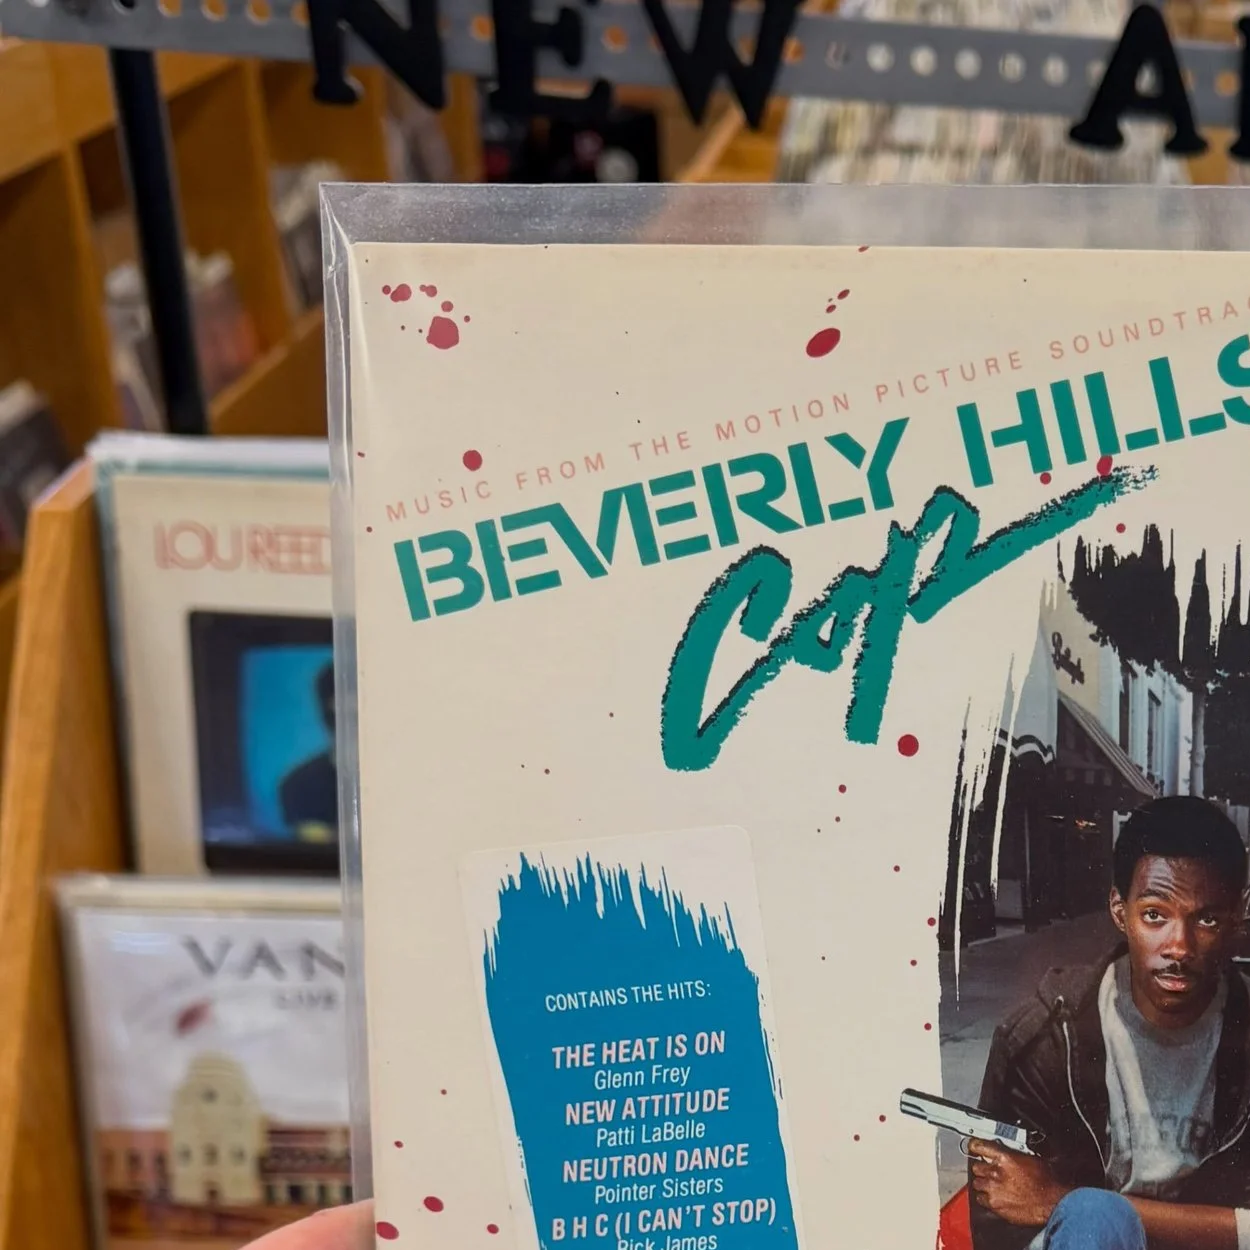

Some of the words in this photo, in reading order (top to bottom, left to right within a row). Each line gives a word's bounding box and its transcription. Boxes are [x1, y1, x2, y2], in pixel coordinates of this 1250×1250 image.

[308, 0, 802, 130] NEW
[386, 479, 493, 522] MUSIC
[514, 451, 606, 490] FROM
[629, 430, 692, 462] THE
[714, 392, 851, 441] MOTION
[875, 350, 1024, 403] PICTURE
[394, 416, 911, 622] BEVERLY
[153, 519, 244, 572] LOU
[661, 464, 1161, 773] Cop
[544, 988, 629, 1013] CONTAINS
[630, 984, 665, 1004] THE
[667, 979, 713, 1001] HITS:
[551, 1042, 596, 1070] THE
[601, 1036, 660, 1066] HEAT
[665, 1033, 688, 1059] IS
[694, 1029, 726, 1056] ON
[593, 1069, 645, 1091] Glenn
[651, 1063, 692, 1087] Frey
[564, 1098, 617, 1126] NEW
[621, 1087, 731, 1121] ATTITUDE
[596, 1125, 635, 1148] Patti
[641, 1119, 706, 1144] LaBelle
[562, 1150, 668, 1183] NEUTRON
[675, 1142, 750, 1173] DANCE
[594, 1182, 657, 1205] Pointer
[661, 1176, 724, 1199] Sisters
[551, 1217, 566, 1241] B
[572, 1215, 588, 1239] H
[594, 1213, 609, 1238] C
[614, 1211, 632, 1241] (I
[637, 1204, 706, 1234] CAN'T
[711, 1196, 778, 1226] STOP)
